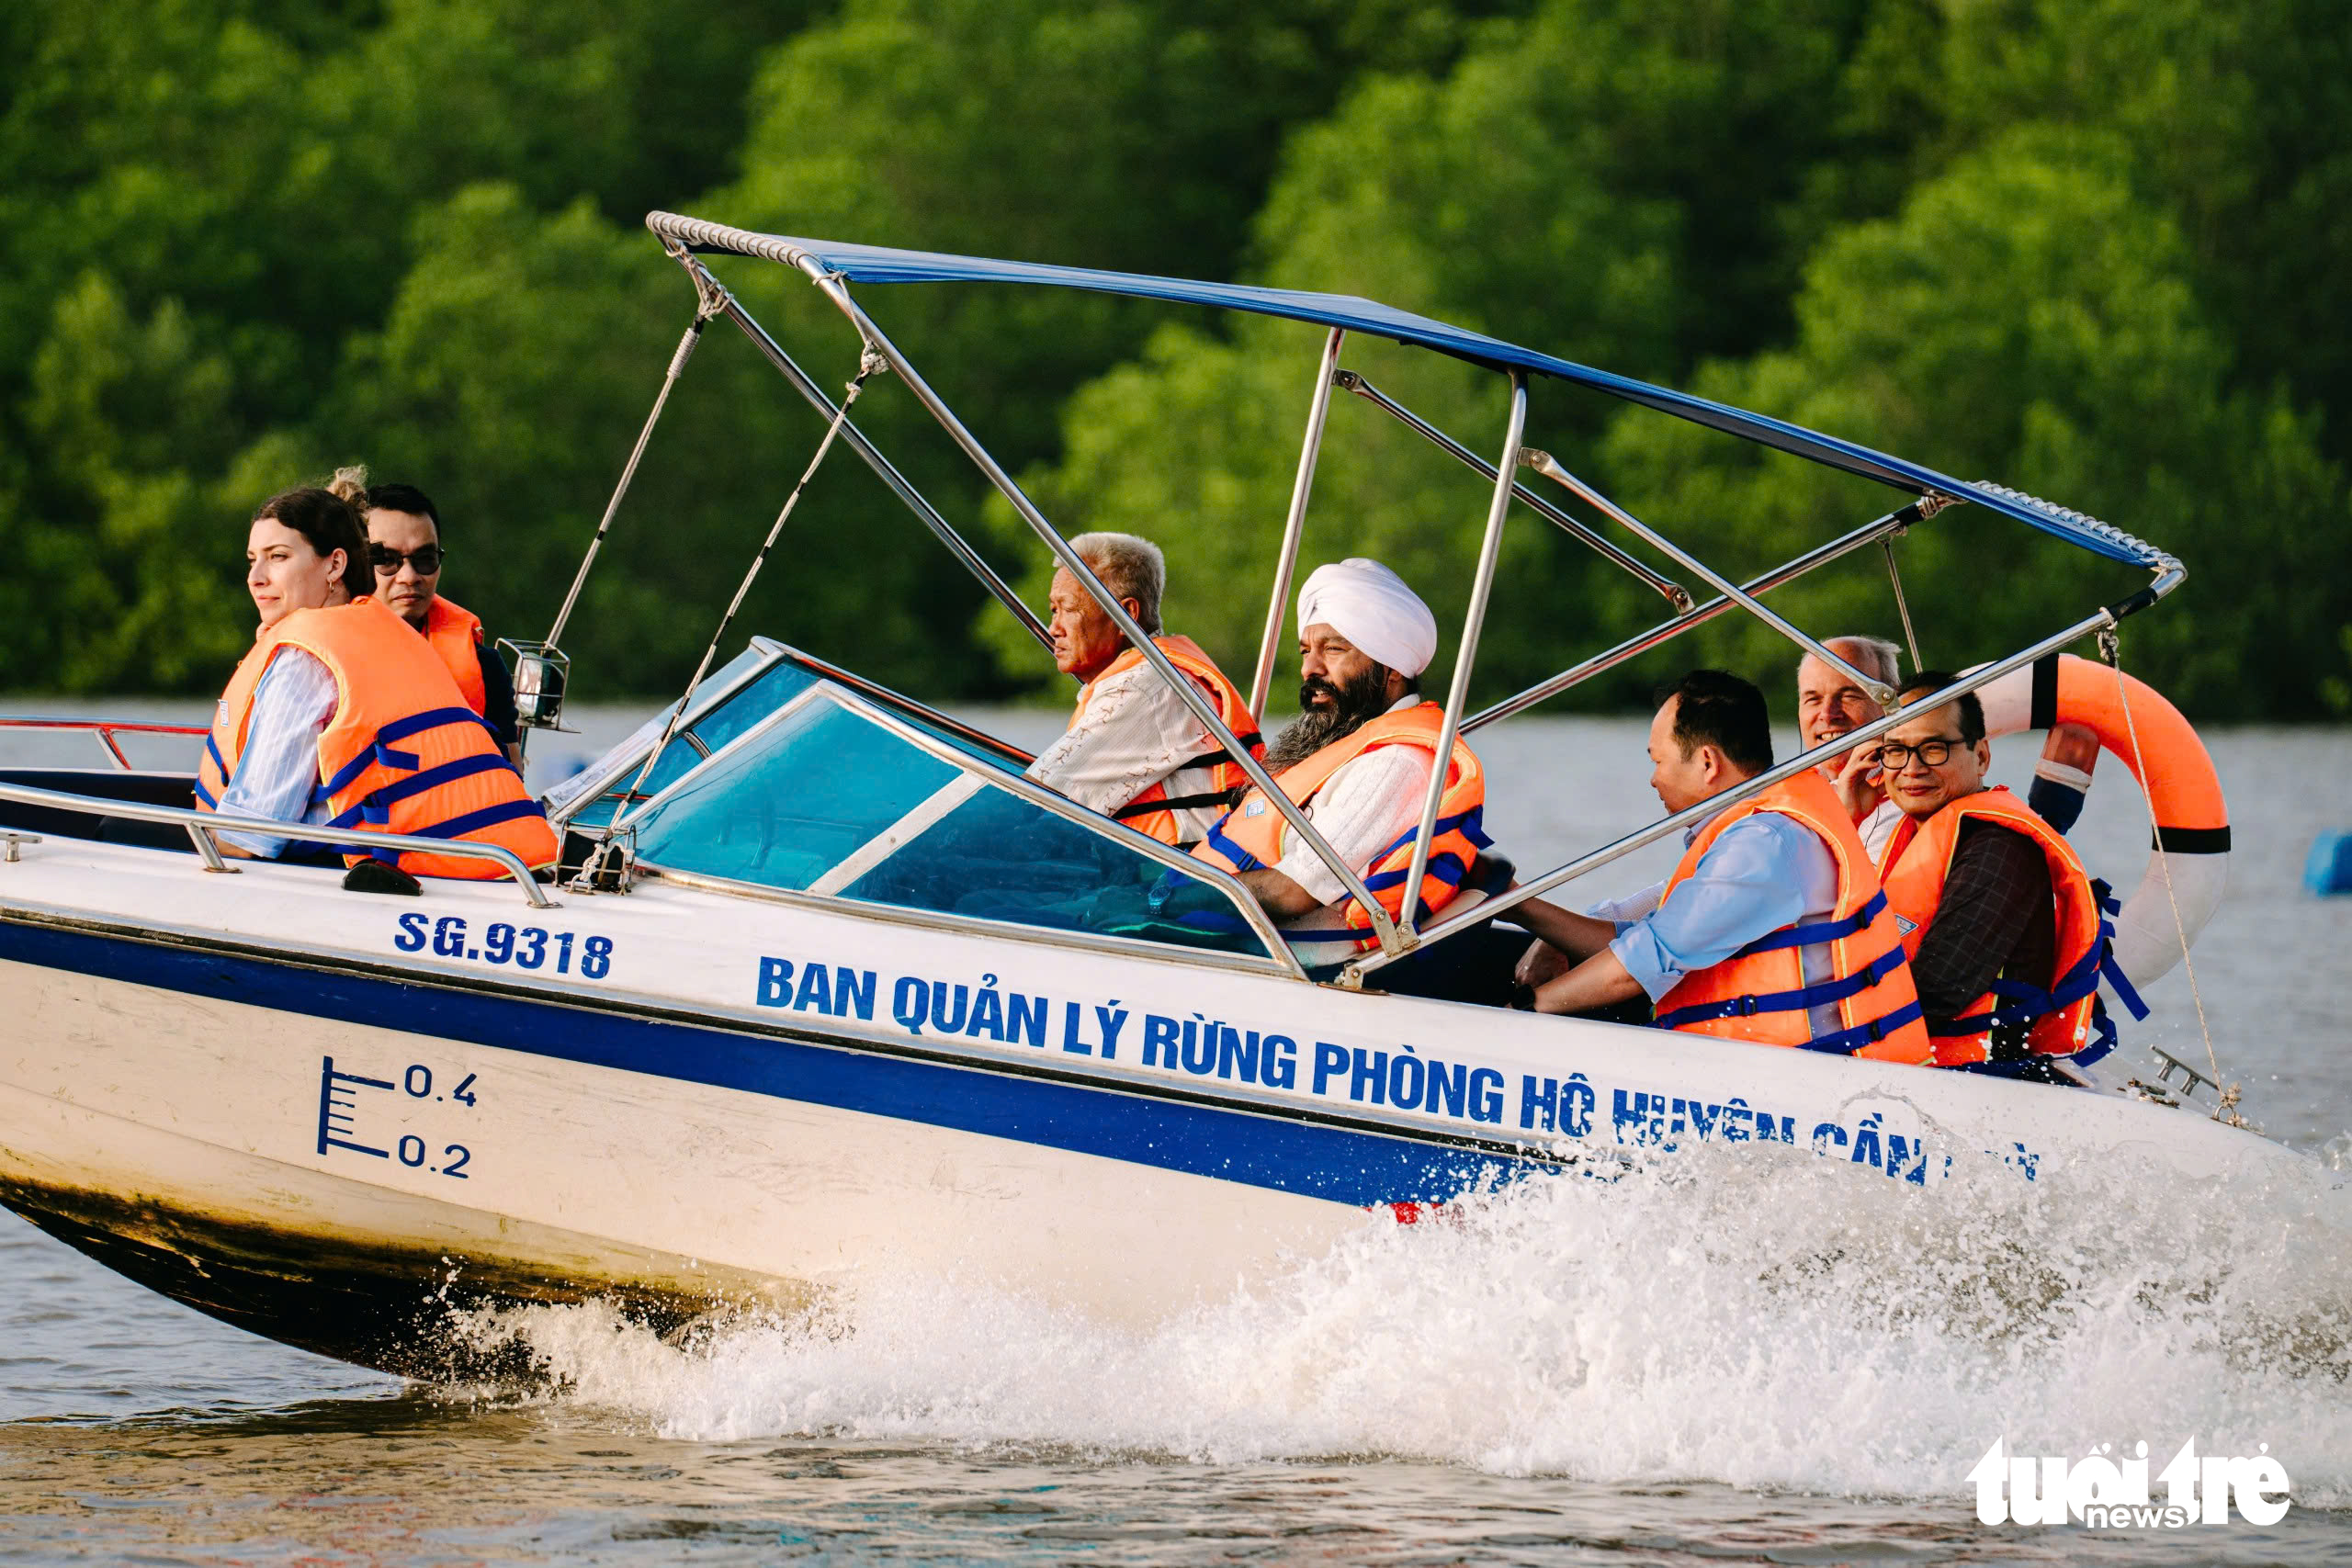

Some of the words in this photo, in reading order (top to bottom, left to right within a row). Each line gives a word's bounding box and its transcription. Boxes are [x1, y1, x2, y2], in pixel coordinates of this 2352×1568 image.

[395, 913, 614, 979] SG.9318
[756, 956, 877, 1021] BAN
[892, 973, 1048, 1048] QUẢN
[1063, 999, 1129, 1059] LÝ
[1141, 1012, 1297, 1090] RỪNG
[1312, 1044, 1505, 1125] PHÒNG
[404, 1064, 478, 1108] 0.4
[398, 1135, 471, 1179] 0.2
